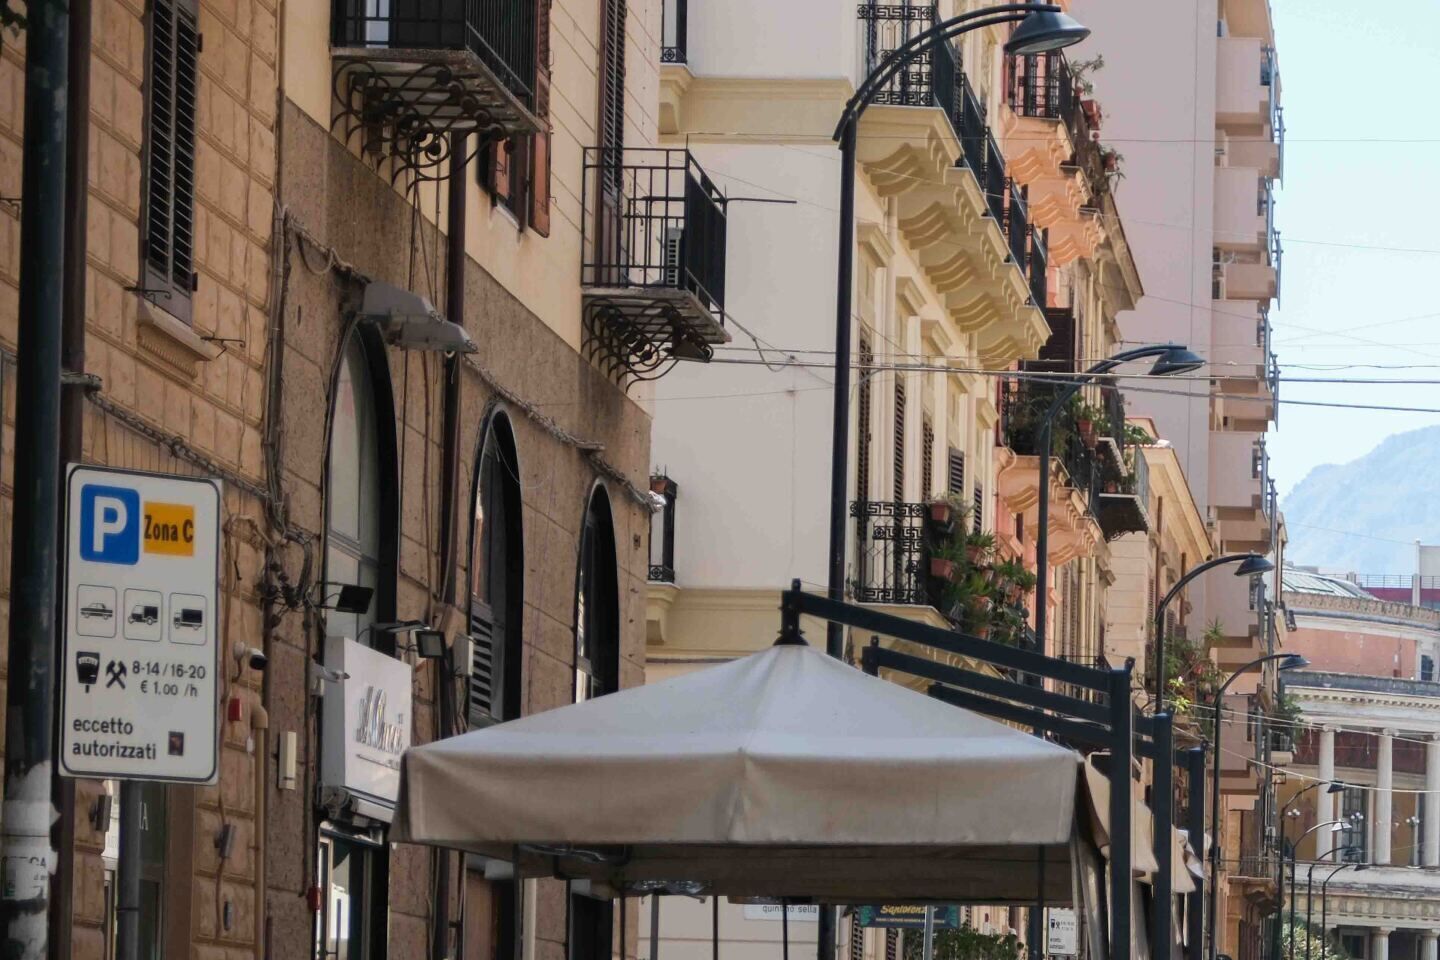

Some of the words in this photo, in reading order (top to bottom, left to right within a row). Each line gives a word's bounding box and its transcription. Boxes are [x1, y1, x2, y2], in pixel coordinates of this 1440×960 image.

[93, 496, 127, 553] P
[144, 514, 178, 542] Zona
[182, 518, 193, 543] C
[132, 660, 160, 676] 8-14
[171, 664, 206, 680] 16-20
[140, 680, 148, 693] €
[73, 718, 133, 735] eccetto
[72, 740, 156, 760] autorizzati
